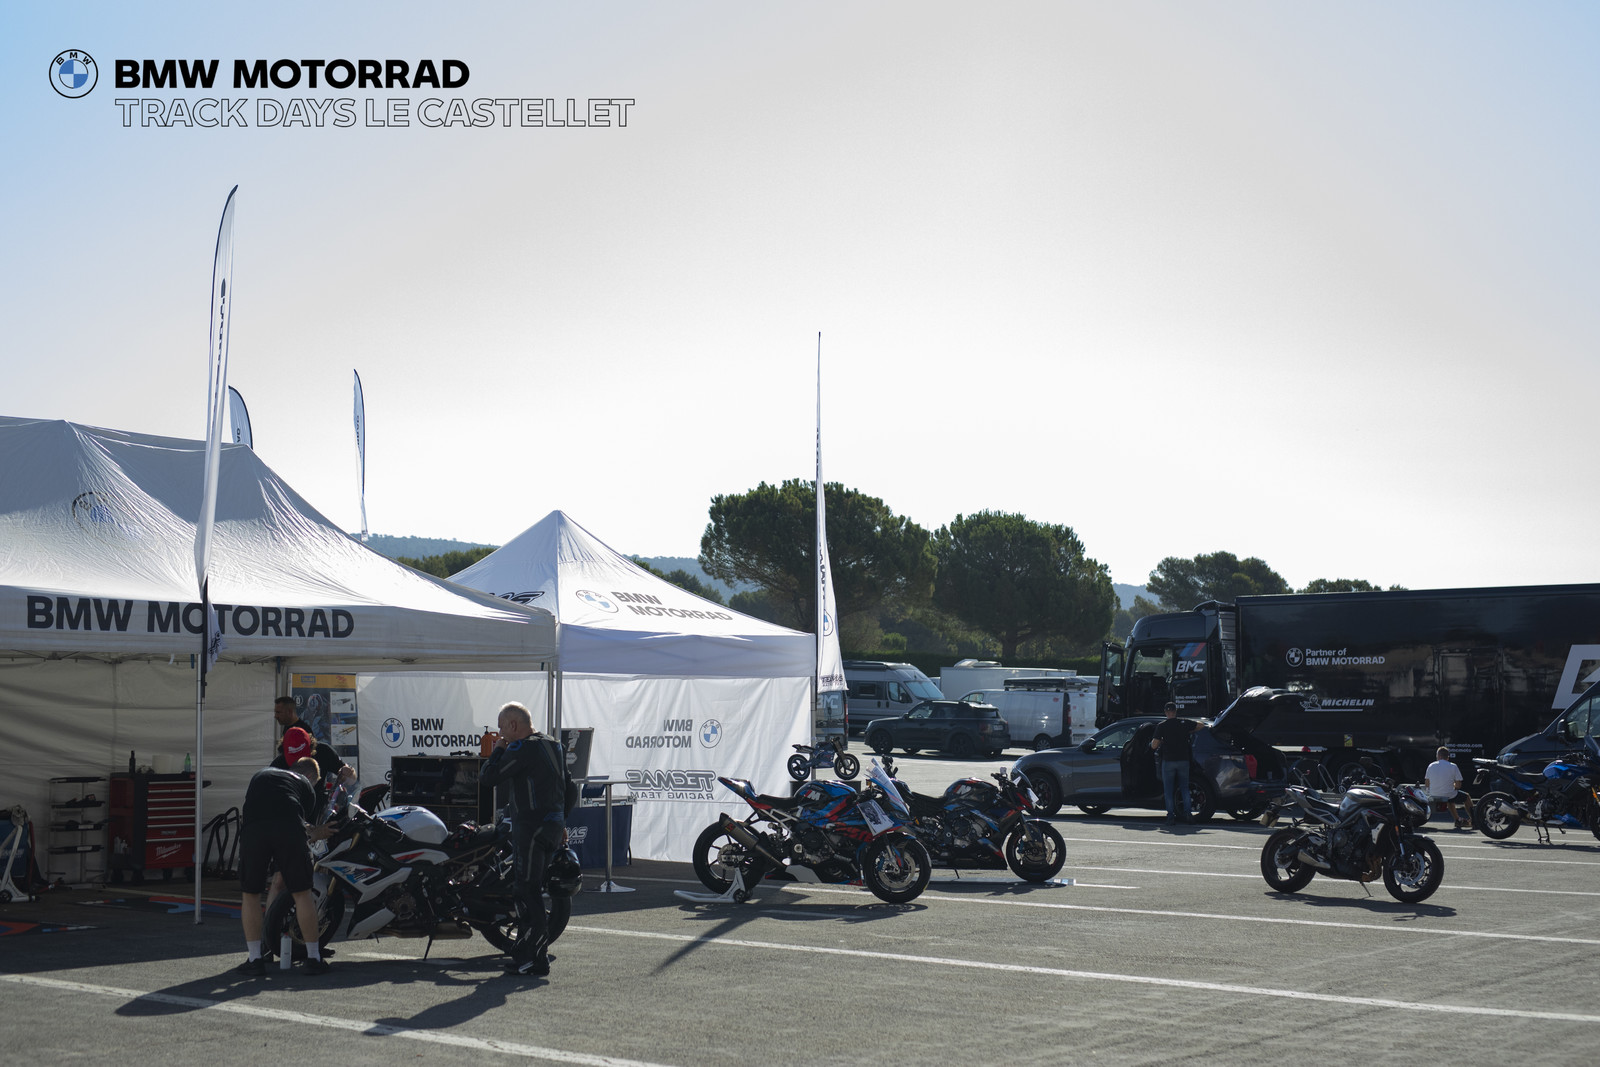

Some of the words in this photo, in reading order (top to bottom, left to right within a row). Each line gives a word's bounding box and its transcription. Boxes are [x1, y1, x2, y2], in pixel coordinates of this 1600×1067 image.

[611, 591, 662, 605] BMW
[27, 596, 133, 631] BMW
[147, 601, 354, 638] MOTORRAD
[627, 605, 733, 621] MOTORRAD
[1305, 648, 1336, 657] Partner
[1337, 648, 1347, 656] of
[1175, 660, 1206, 672] BMC
[1305, 657, 1330, 666] BMW
[1332, 656, 1385, 665] MOTORRAD
[411, 718, 444, 731] BMW
[412, 734, 481, 748] MOTORRAD
